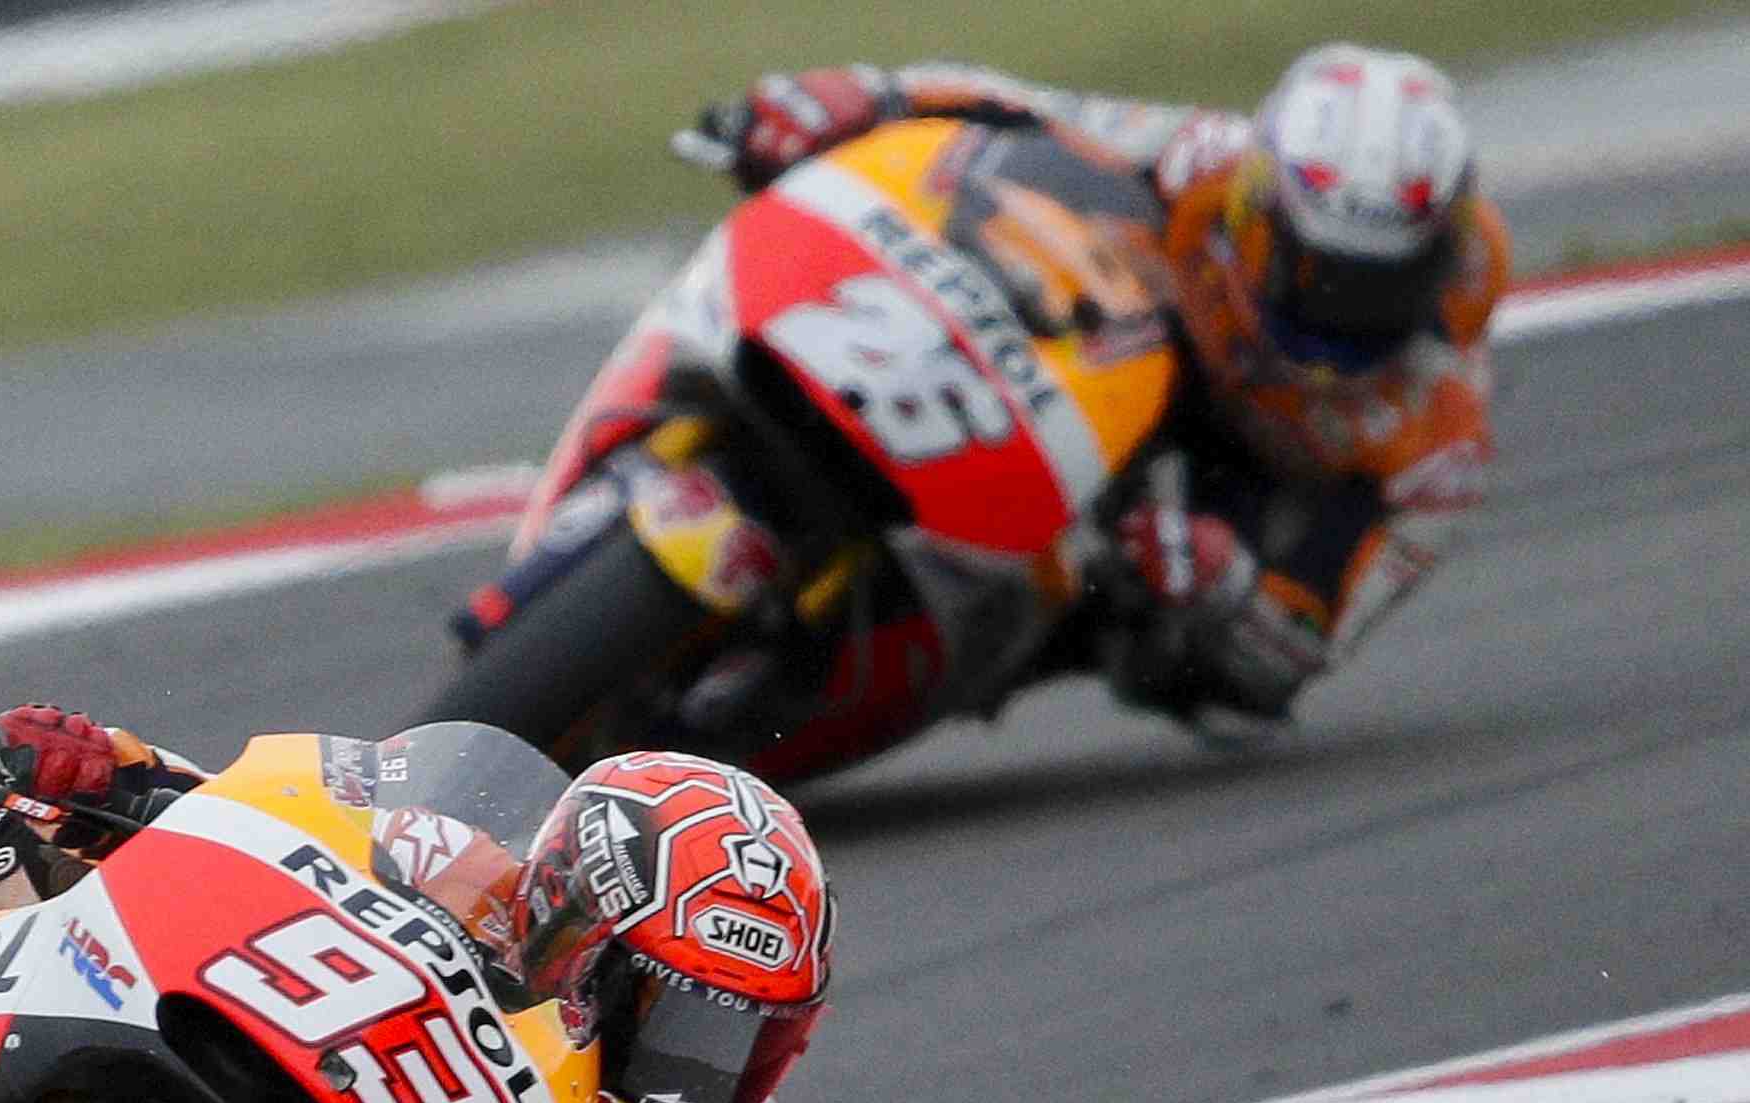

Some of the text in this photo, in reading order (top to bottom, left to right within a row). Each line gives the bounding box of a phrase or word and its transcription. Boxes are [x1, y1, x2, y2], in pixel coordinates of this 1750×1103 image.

[761, 274, 1012, 457] 26
[862, 208, 1057, 412] REPSOL
[578, 803, 632, 918] LOTUS
[629, 952, 693, 993] GIVES
[704, 986, 750, 1013] YOU
[707, 915, 784, 961] SHOEI
